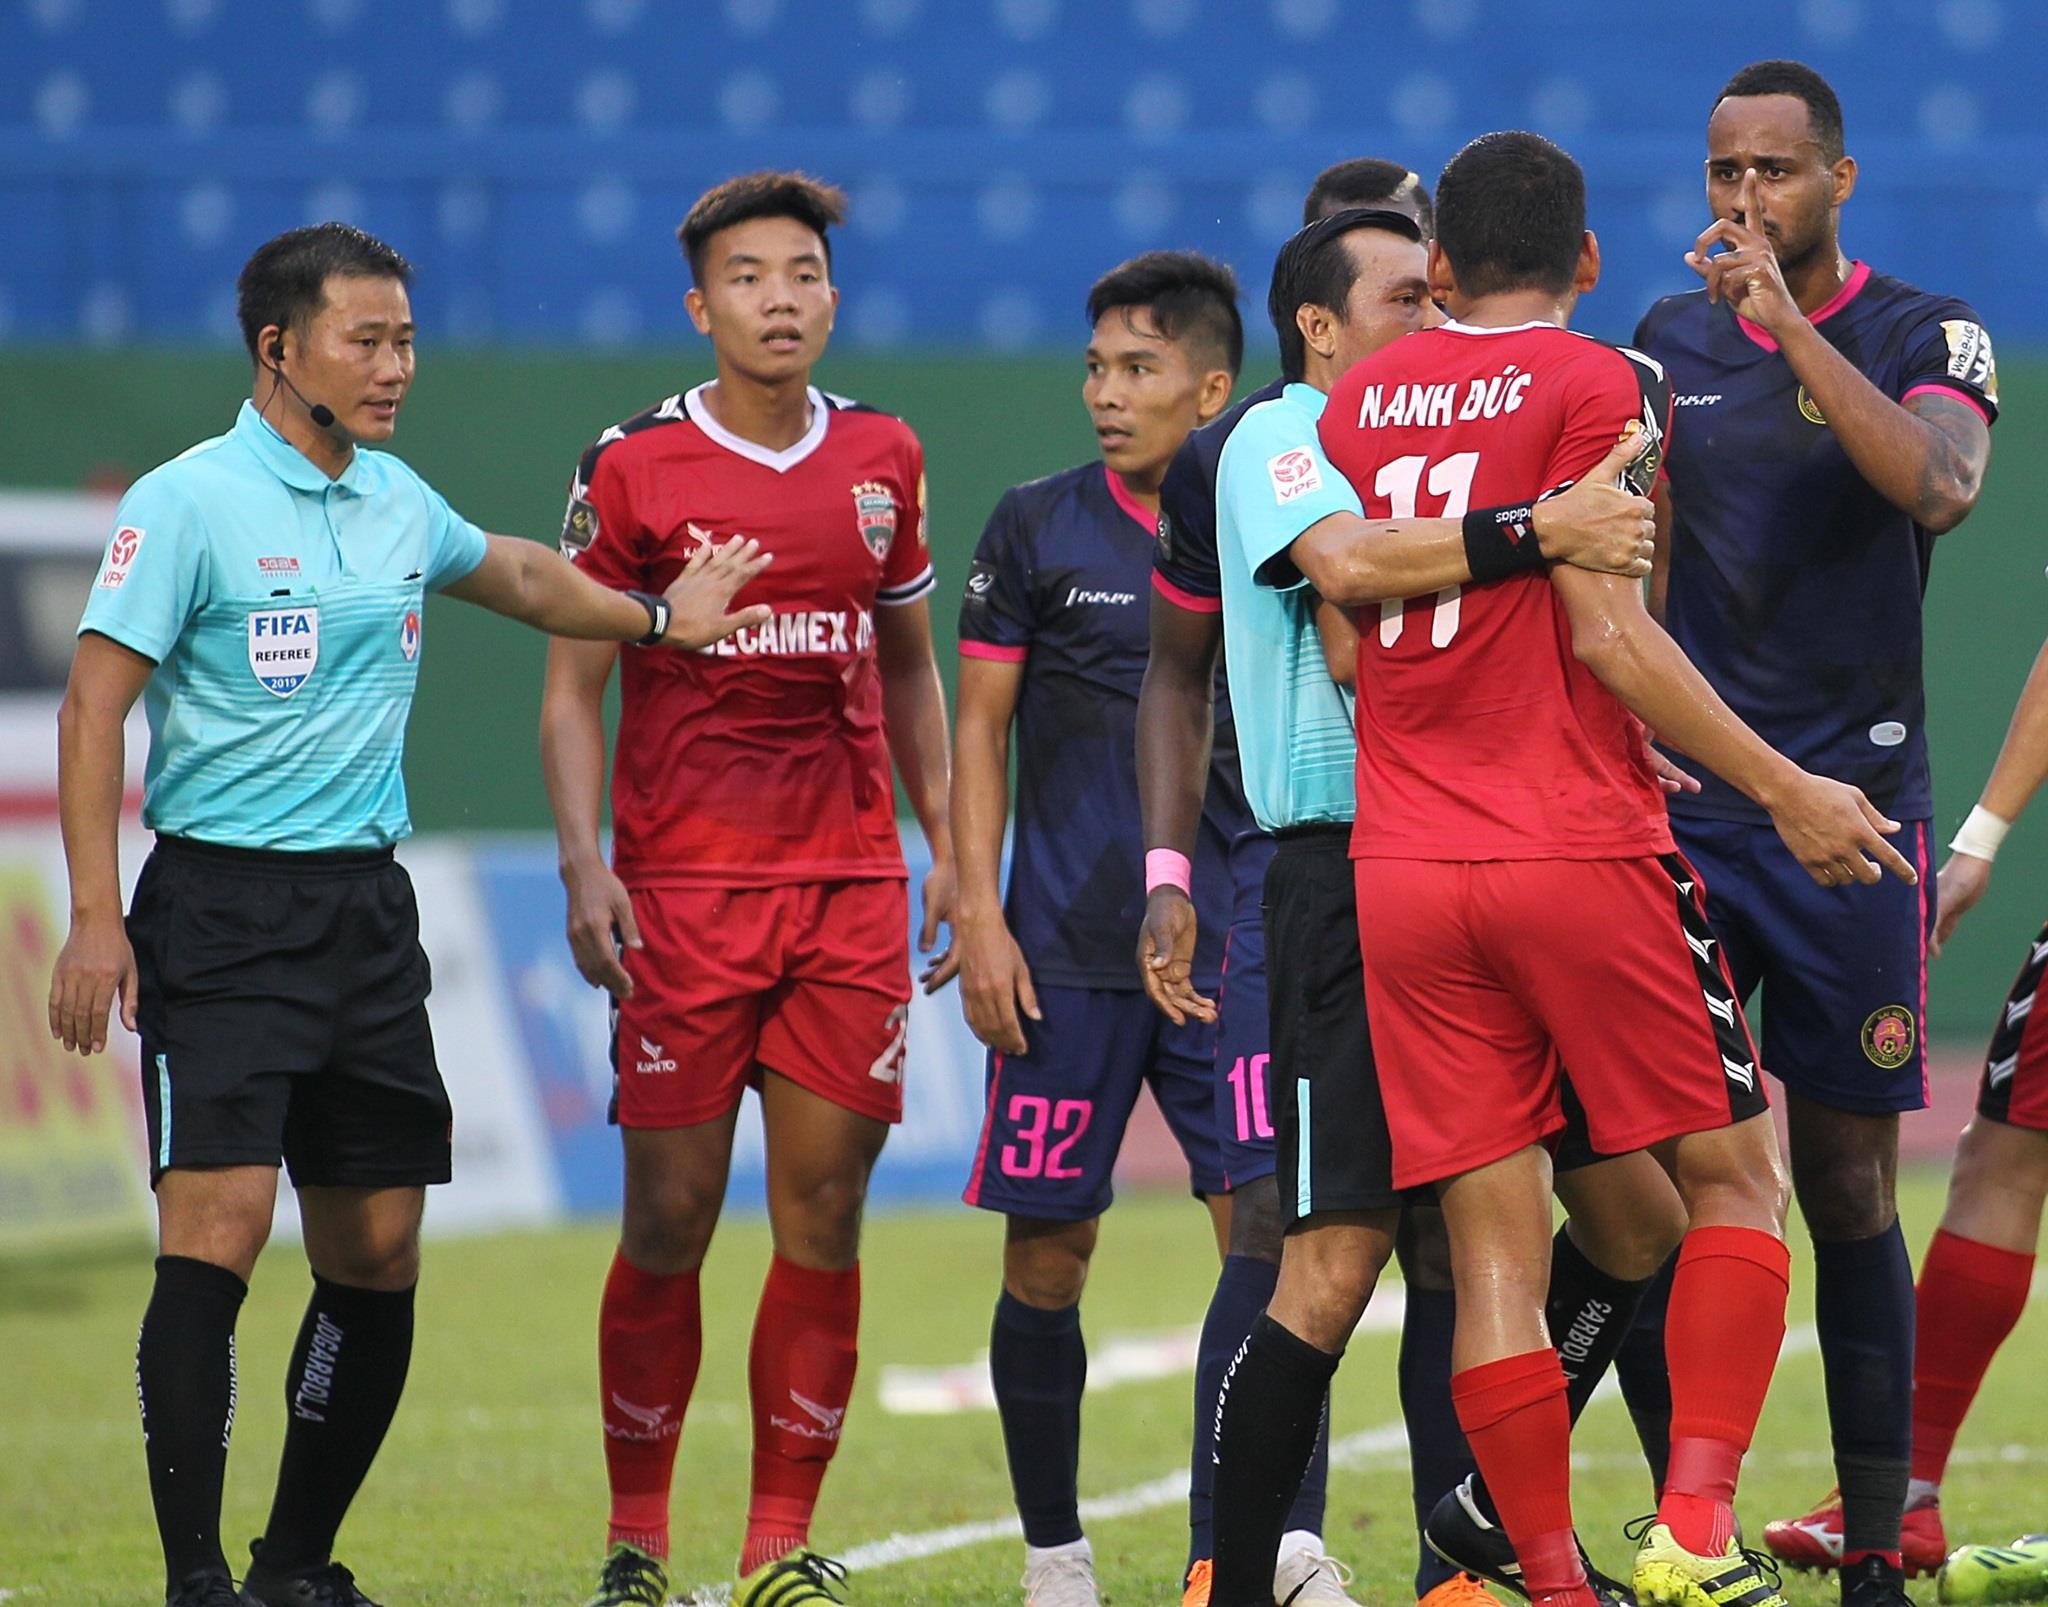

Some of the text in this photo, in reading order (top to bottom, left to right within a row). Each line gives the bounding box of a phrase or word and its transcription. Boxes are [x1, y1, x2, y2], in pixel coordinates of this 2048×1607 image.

[1357, 383, 1457, 429] N.ANH
[1279, 477, 1318, 498] VPF
[1374, 451, 1480, 648] 11
[103, 570, 126, 586] VPF
[255, 614, 311, 637] FIFA
[699, 610, 849, 657] ECAMEX
[255, 648, 312, 662] REFEREE
[271, 676, 297, 689] 2019
[636, 1059, 677, 1073] KAMITO
[1001, 1093, 1093, 1180] 32
[294, 1311, 344, 1422] JOGARBOLA
